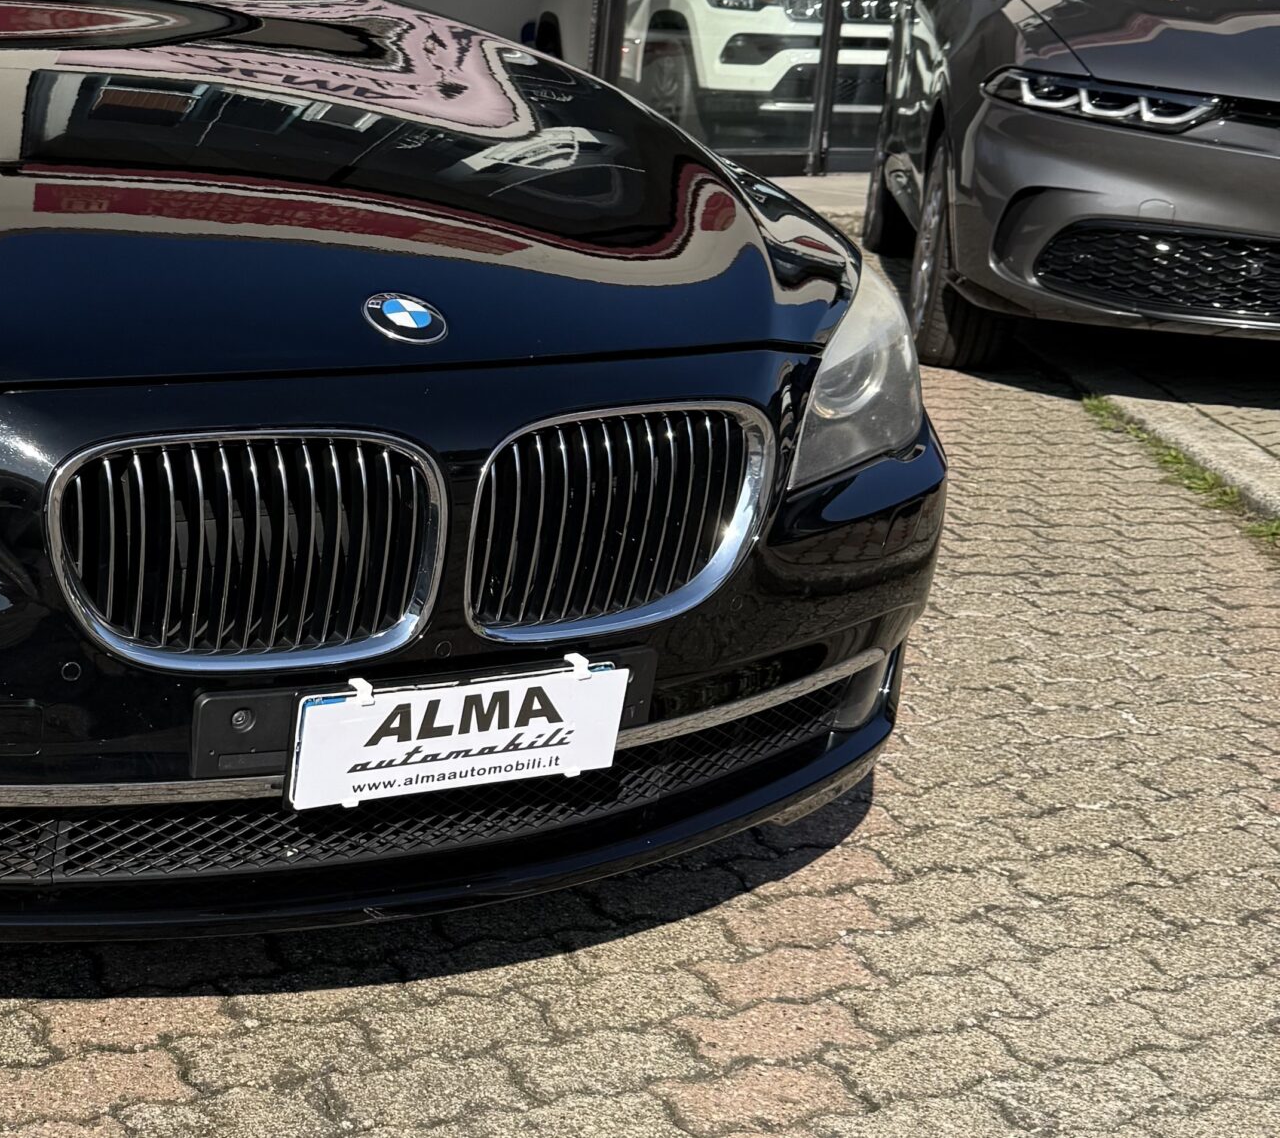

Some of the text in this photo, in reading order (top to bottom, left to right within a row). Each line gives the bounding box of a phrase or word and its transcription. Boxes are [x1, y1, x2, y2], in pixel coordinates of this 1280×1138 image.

[364, 686, 564, 747] ALMA
[347, 729, 574, 774] automobili
[352, 755, 561, 793] www.almaautomobili.it
